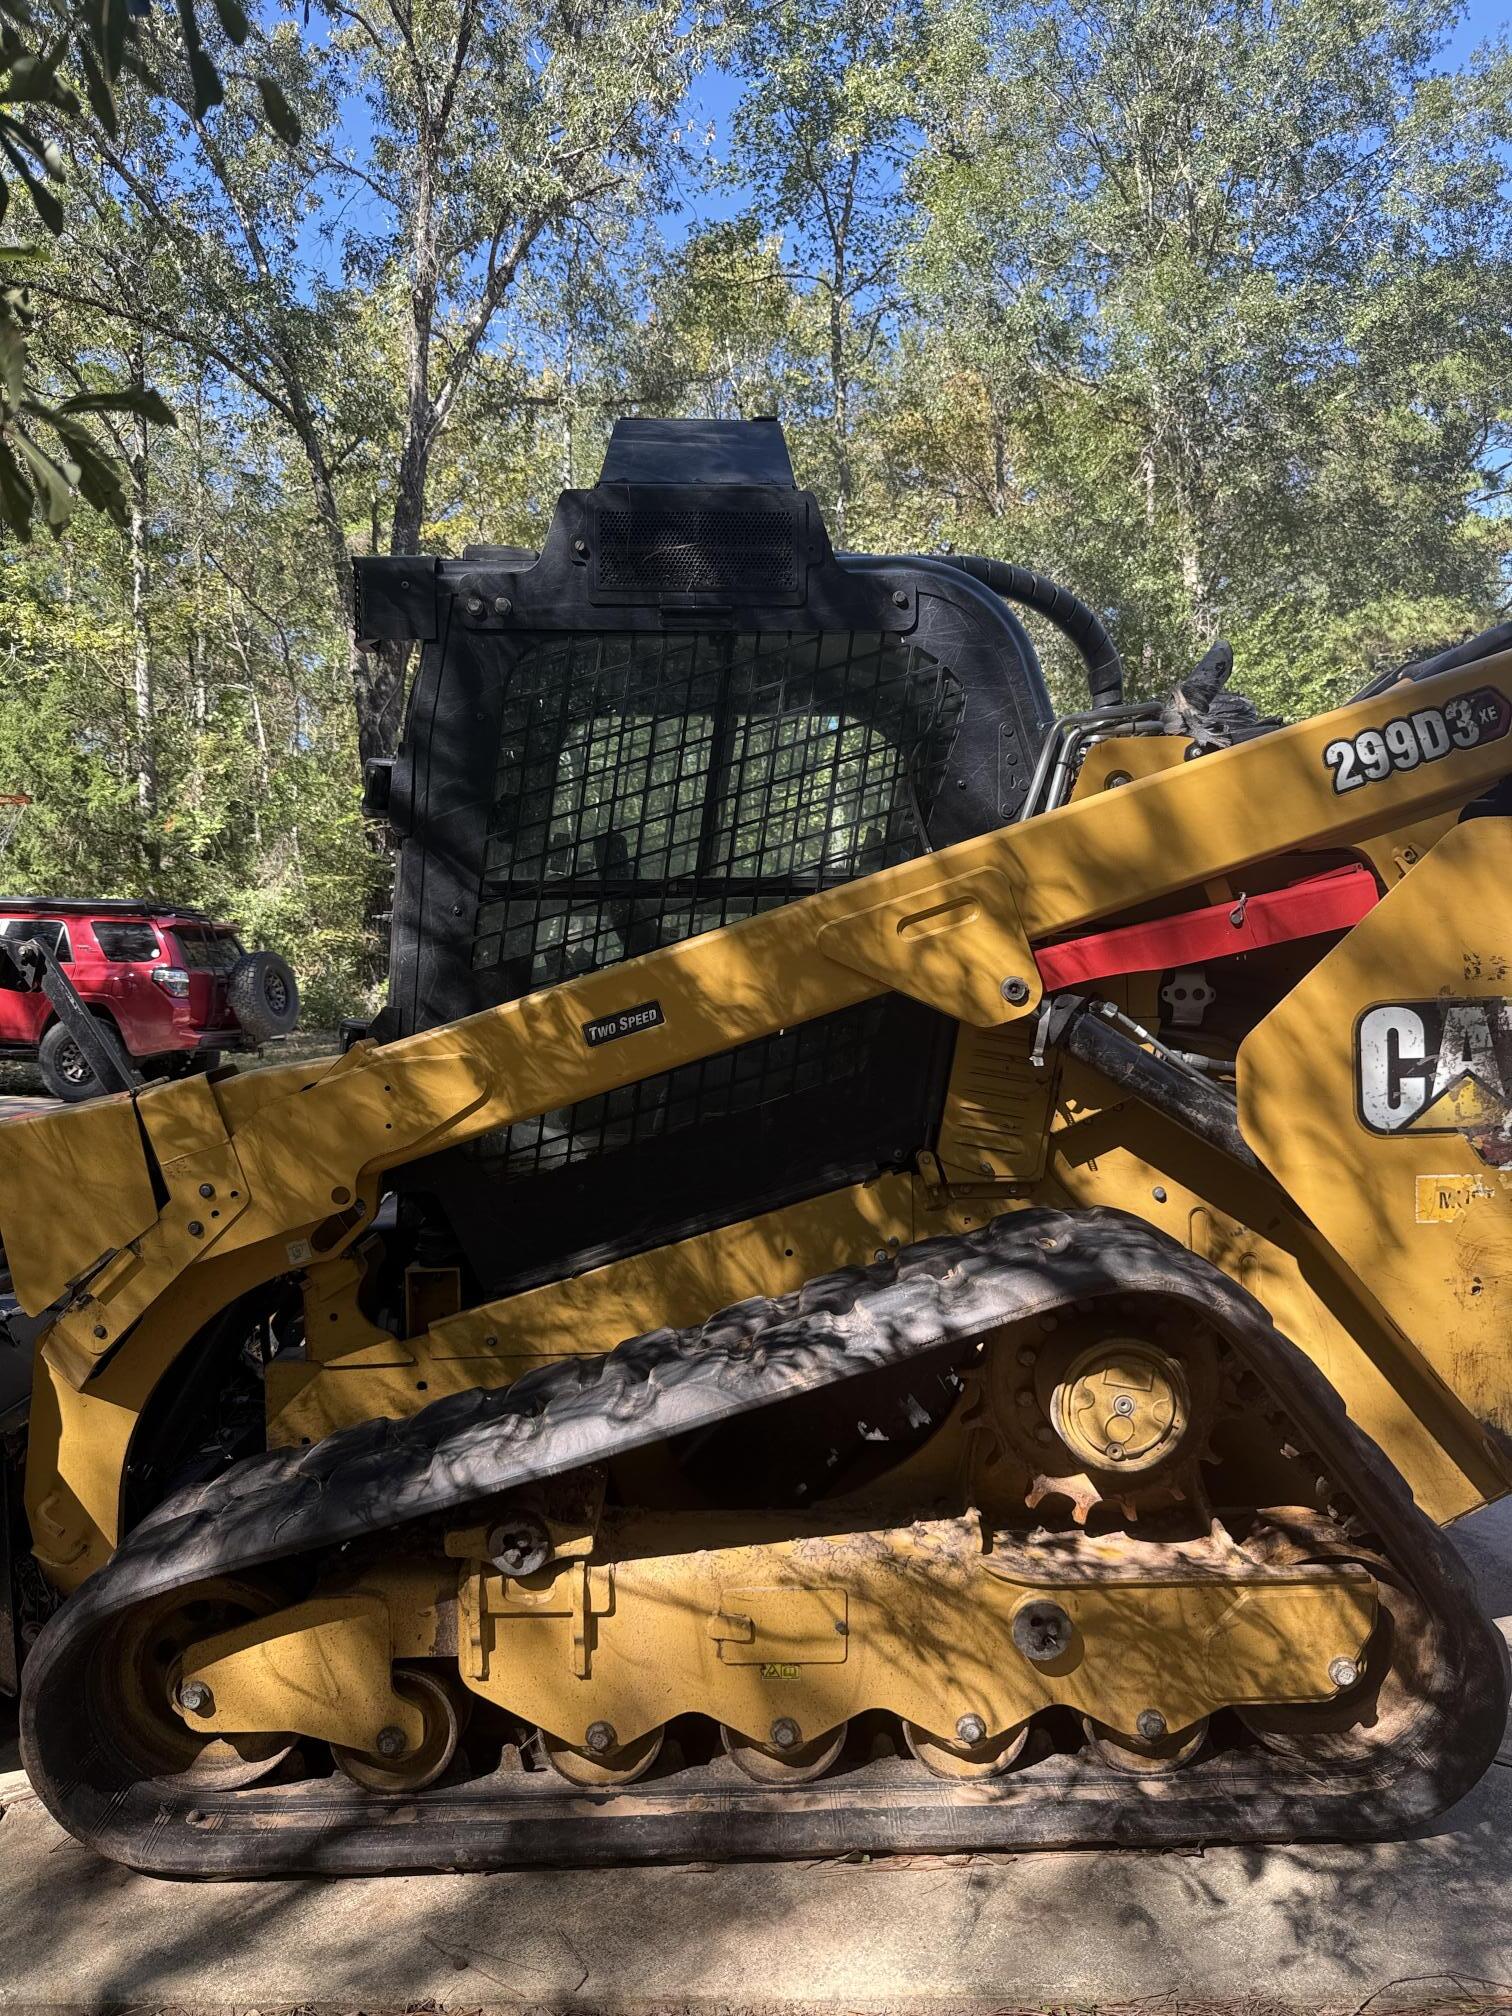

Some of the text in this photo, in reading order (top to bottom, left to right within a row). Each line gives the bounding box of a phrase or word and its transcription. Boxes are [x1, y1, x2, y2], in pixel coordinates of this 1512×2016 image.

[1325, 699, 1499, 792] 299D3 XE
[1360, 1006, 1512, 1130] CA
